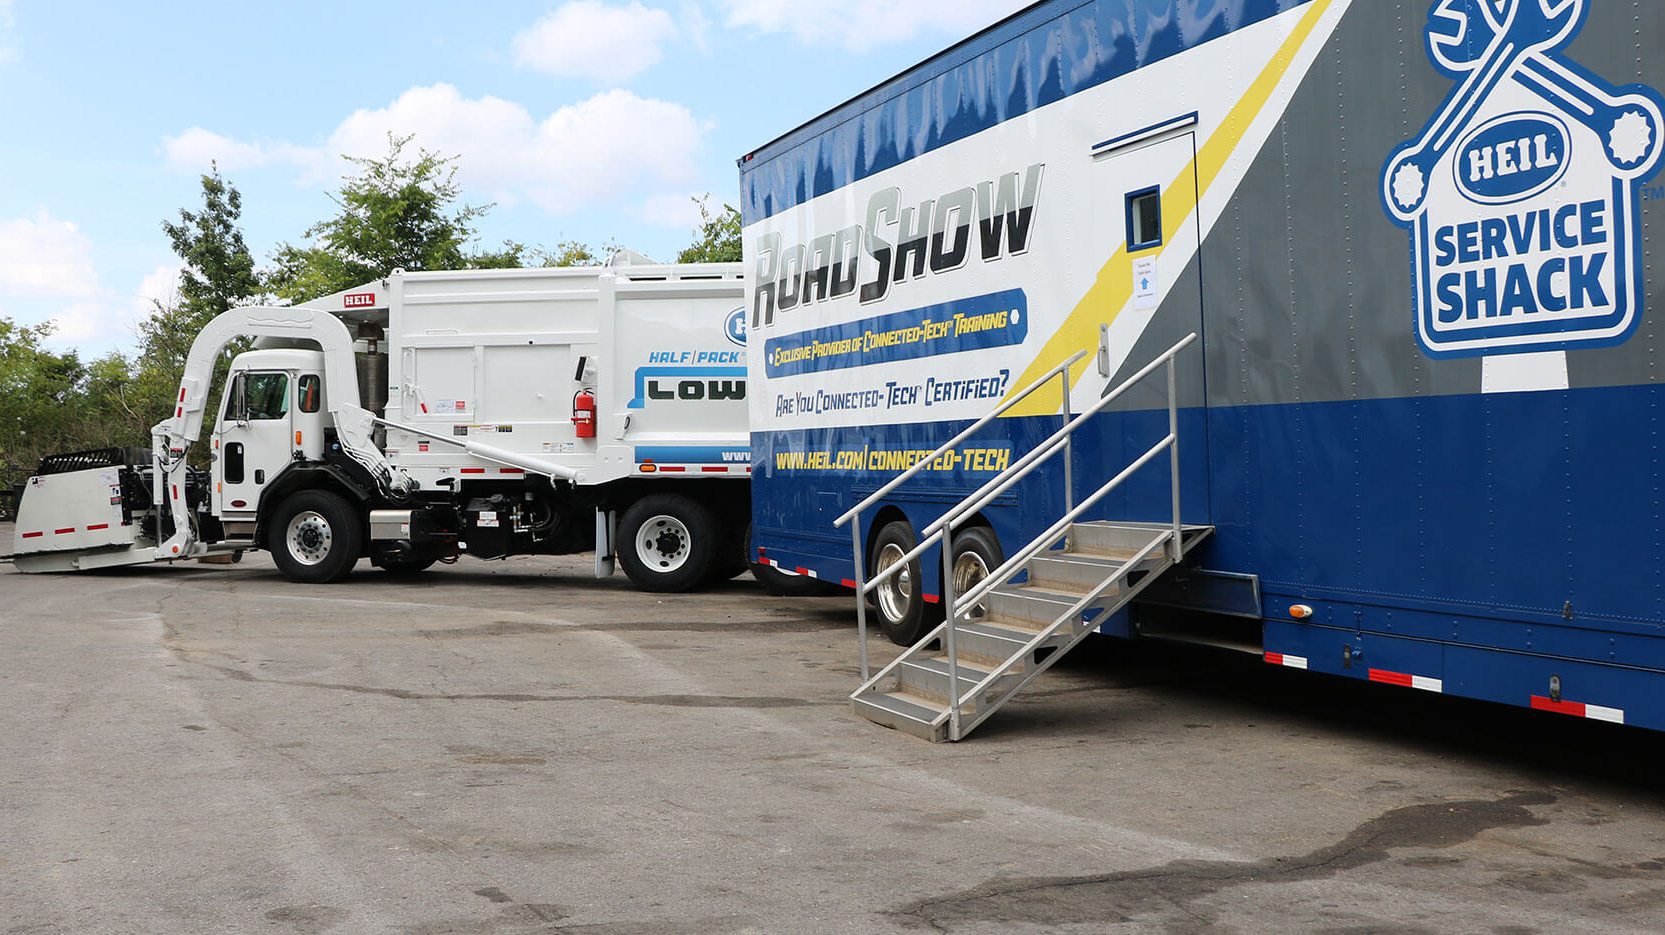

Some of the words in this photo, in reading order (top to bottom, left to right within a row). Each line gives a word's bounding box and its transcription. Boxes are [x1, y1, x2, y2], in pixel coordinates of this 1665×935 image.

[1469, 134, 1558, 182] HEIL
[1434, 199, 1607, 267] SERVICE
[345, 295, 373, 306] HEIL
[1436, 252, 1610, 323] SHACK
[774, 346, 812, 367] EXCLUSIVE
[811, 340, 851, 361] PROVIDER
[851, 337, 863, 352] OF
[953, 310, 1008, 338] TRAINING
[776, 394, 794, 418] ARE
[796, 391, 814, 417] YOU
[924, 369, 1010, 406] CERTIFIED?
